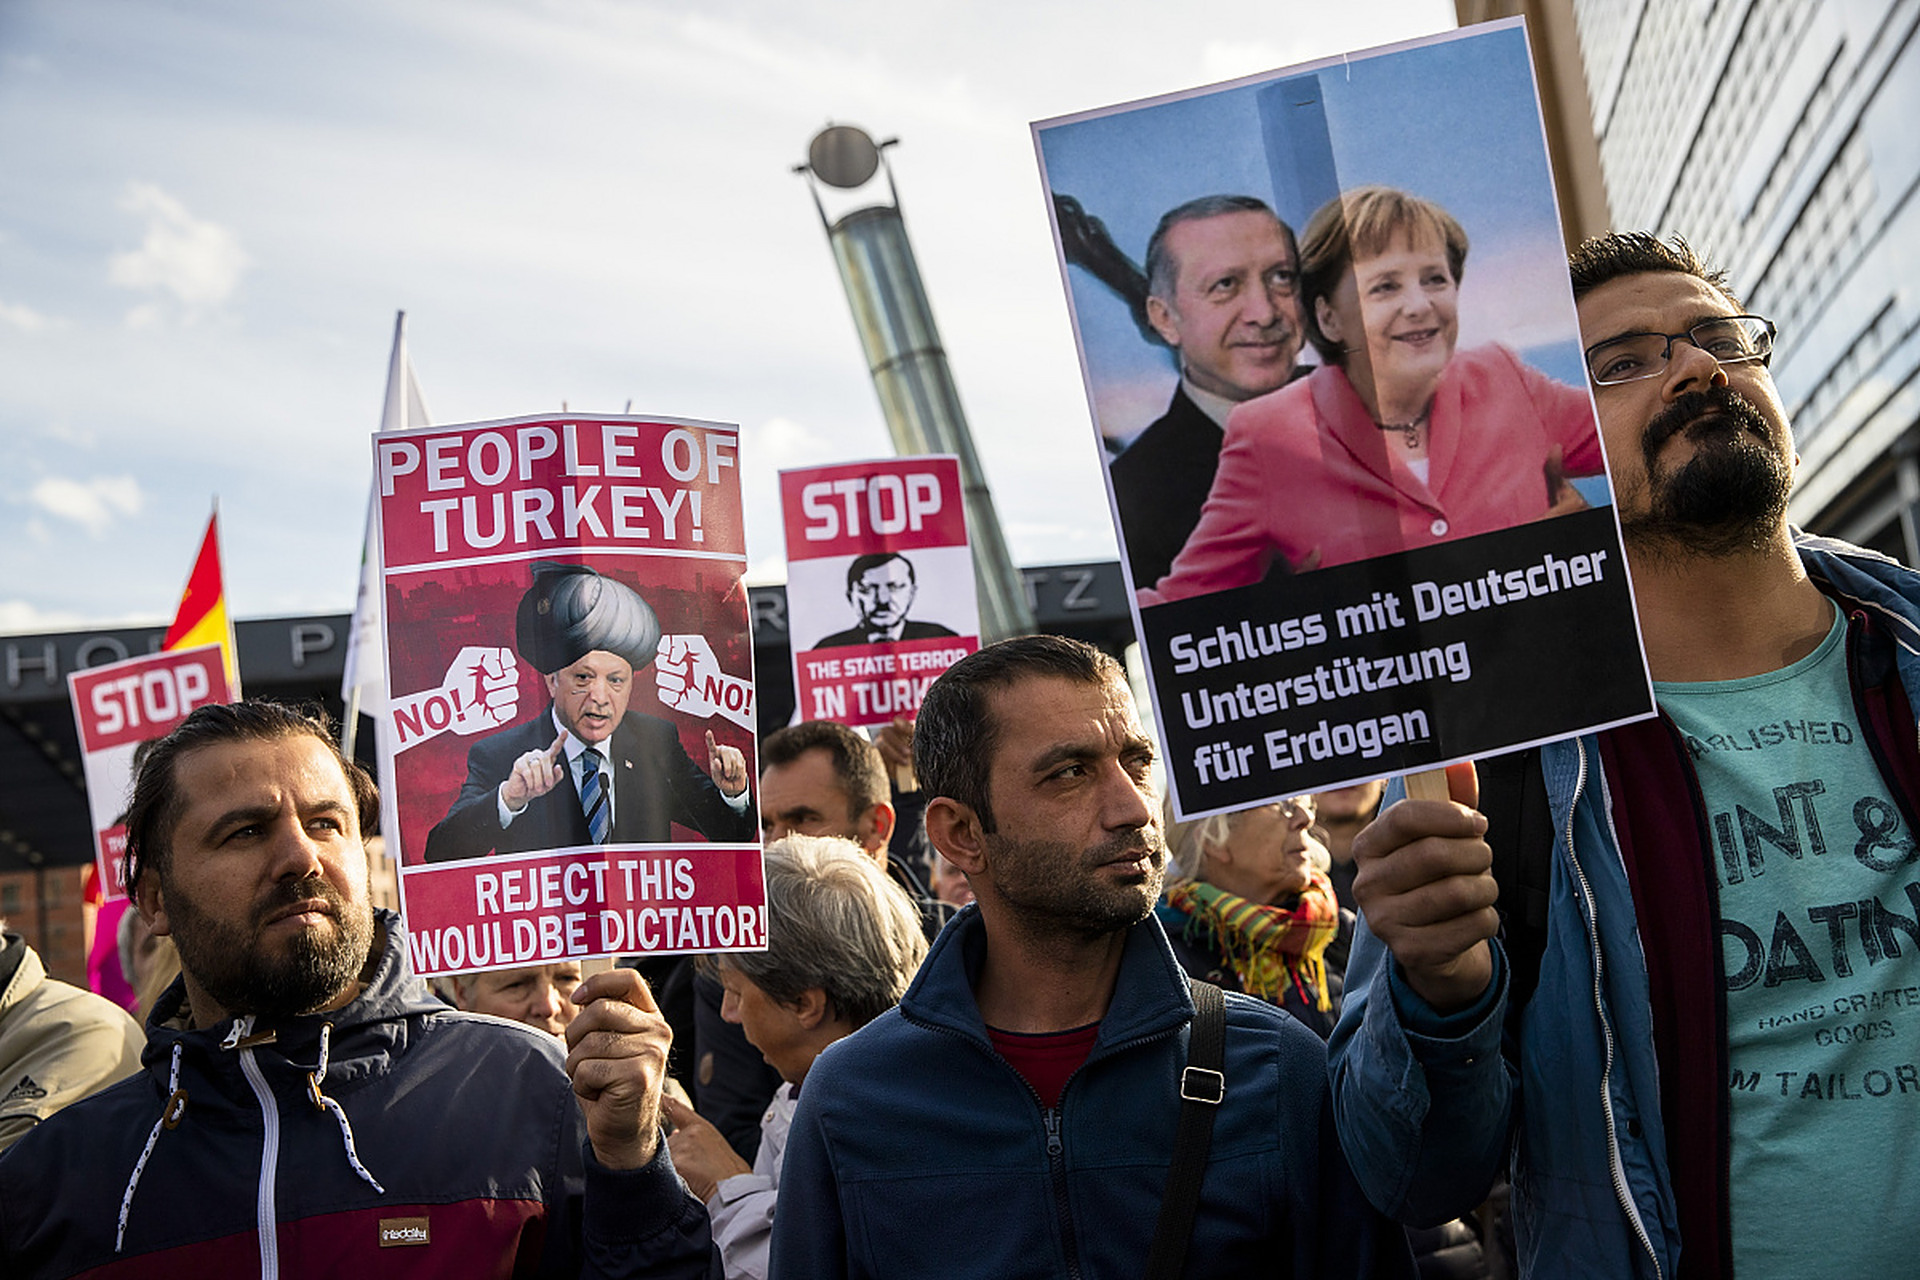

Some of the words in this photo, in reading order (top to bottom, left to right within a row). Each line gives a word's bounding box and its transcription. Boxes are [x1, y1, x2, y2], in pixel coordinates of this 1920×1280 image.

[379, 424, 641, 496] PEOPLE
[661, 429, 737, 484] OF
[420, 486, 704, 552] TURKEY!
[801, 474, 942, 541] STOP
[1170, 611, 1327, 674] Schluss
[1335, 592, 1406, 640] mit
[1412, 549, 1607, 623] Deutscher
[91, 663, 209, 735] STOP
[703, 675, 753, 716] NO!
[807, 660, 842, 681] THE
[844, 655, 895, 677] STATE
[812, 684, 847, 719] IN
[851, 676, 938, 715] TURK
[1182, 641, 1472, 730] Unterstützung
[394, 689, 465, 743] NO!
[1193, 743, 1254, 786] für
[1264, 709, 1431, 771] Erdogan
[1852, 796, 1919, 875] &
[475, 860, 610, 916] REJECT
[618, 858, 695, 901] THIS
[410, 912, 588, 973] WOULDBE
[600, 905, 767, 952] DICTATOR!
[1758, 1005, 1825, 1030] HAND
[1833, 987, 1920, 1015] CRAFTE
[1815, 1020, 1895, 1047] GOODS
[1776, 1064, 1920, 1101] TAILOR
